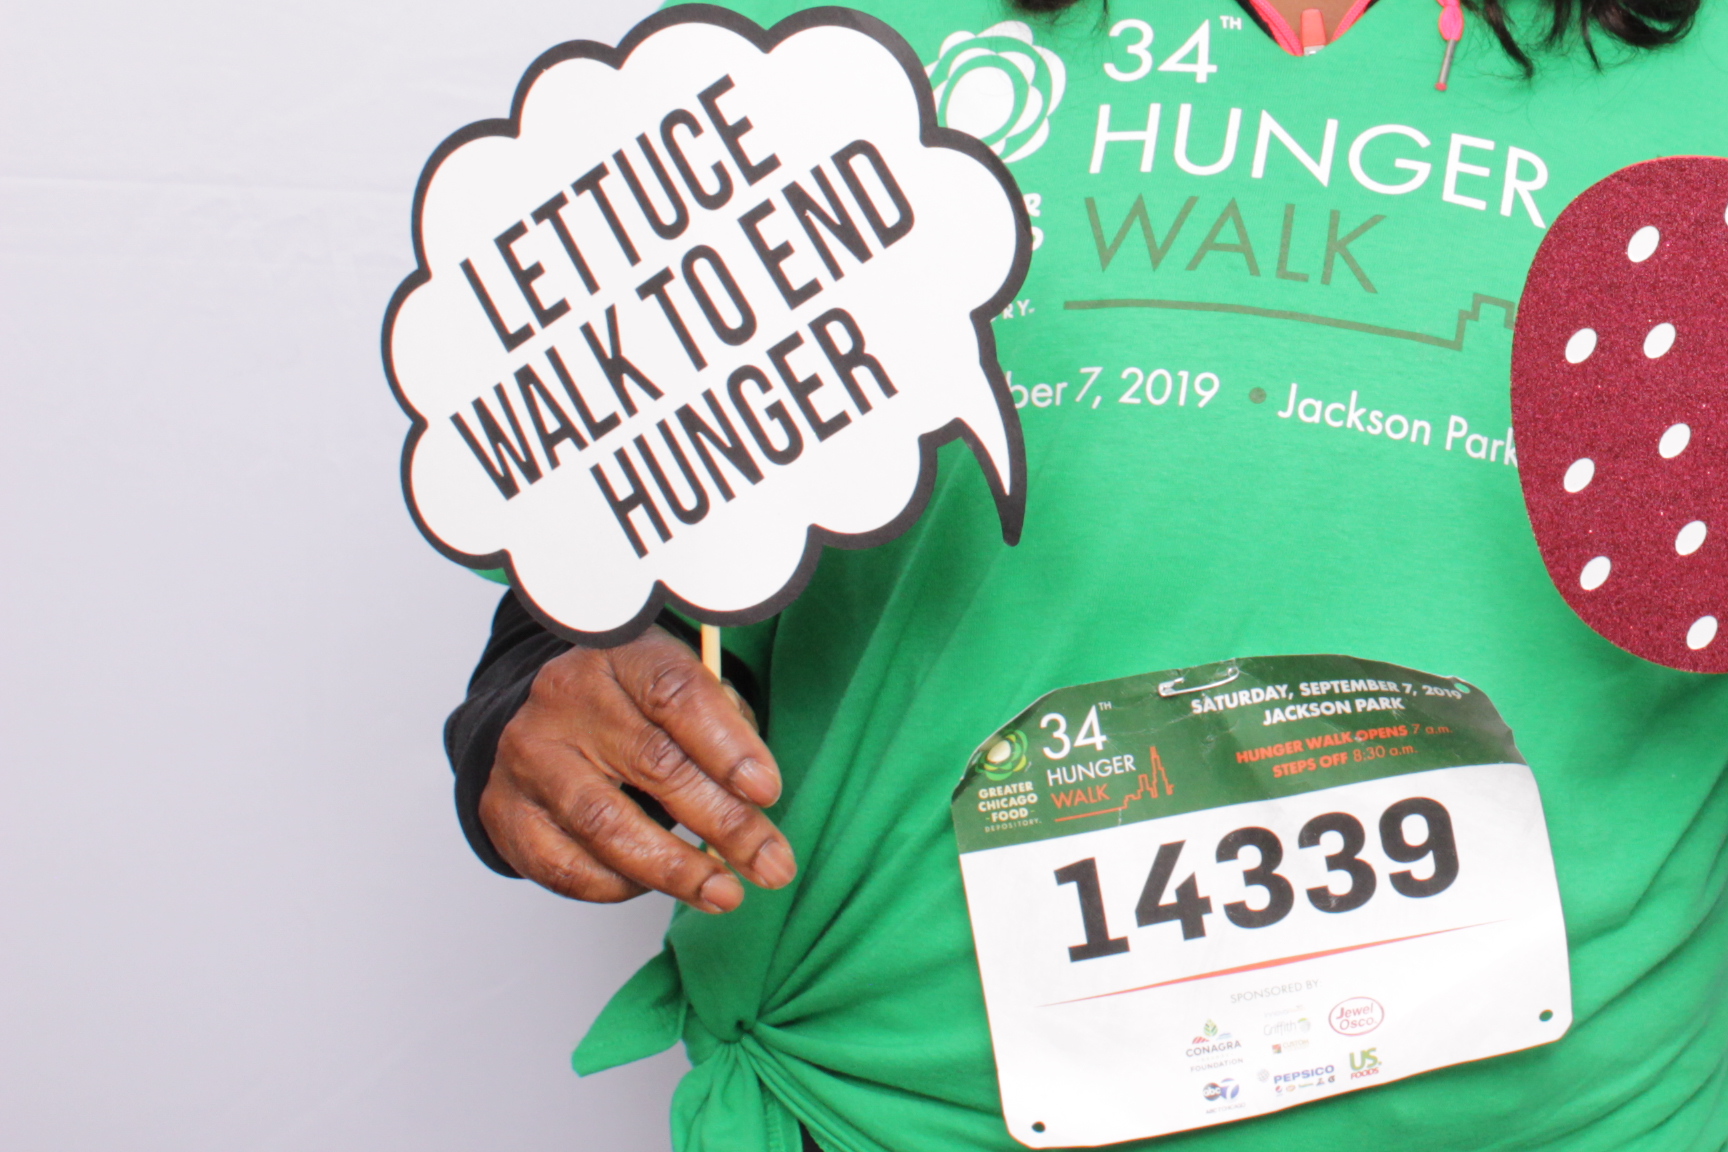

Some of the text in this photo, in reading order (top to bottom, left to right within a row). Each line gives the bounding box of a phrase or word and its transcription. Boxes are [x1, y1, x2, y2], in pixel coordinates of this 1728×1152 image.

[1089, 102, 1549, 229] HUNGER
[459, 73, 782, 353] LETTUCE
[1084, 193, 1387, 294] WALK
[449, 139, 915, 501] WALK TO END
[1073, 367, 1103, 410] 7,
[1119, 367, 1220, 408] 2019
[590, 307, 899, 560] HUNGER
[1277, 383, 1518, 468] Jackson Park
[1191, 679, 1463, 715] SATURDAY, SEPTEMBER 7, 2019
[1262, 697, 1405, 726] JACKSON PARK
[1236, 723, 1453, 763] HUNGER WALK OPENS 7 a.m.
[1047, 754, 1136, 786] HUNGER
[1272, 744, 1418, 778] STEPS OFF 8:30 a.m.
[978, 781, 1034, 799] GREATER
[978, 793, 1038, 812] CHICAGO
[1051, 784, 1111, 809] WALK
[991, 808, 1029, 823] FOOD
[1053, 796, 1461, 964] 14339
[1230, 982, 1303, 1004] SPONSORED
[1336, 1002, 1373, 1020] Jewel
[1263, 1019, 1297, 1037] Griffith
[1185, 1040, 1243, 1058] CONAGRA
[1190, 1057, 1244, 1073] FOUNDATION
[1273, 1064, 1335, 1085] PEPSICO
[1350, 1067, 1379, 1080] FOODS
